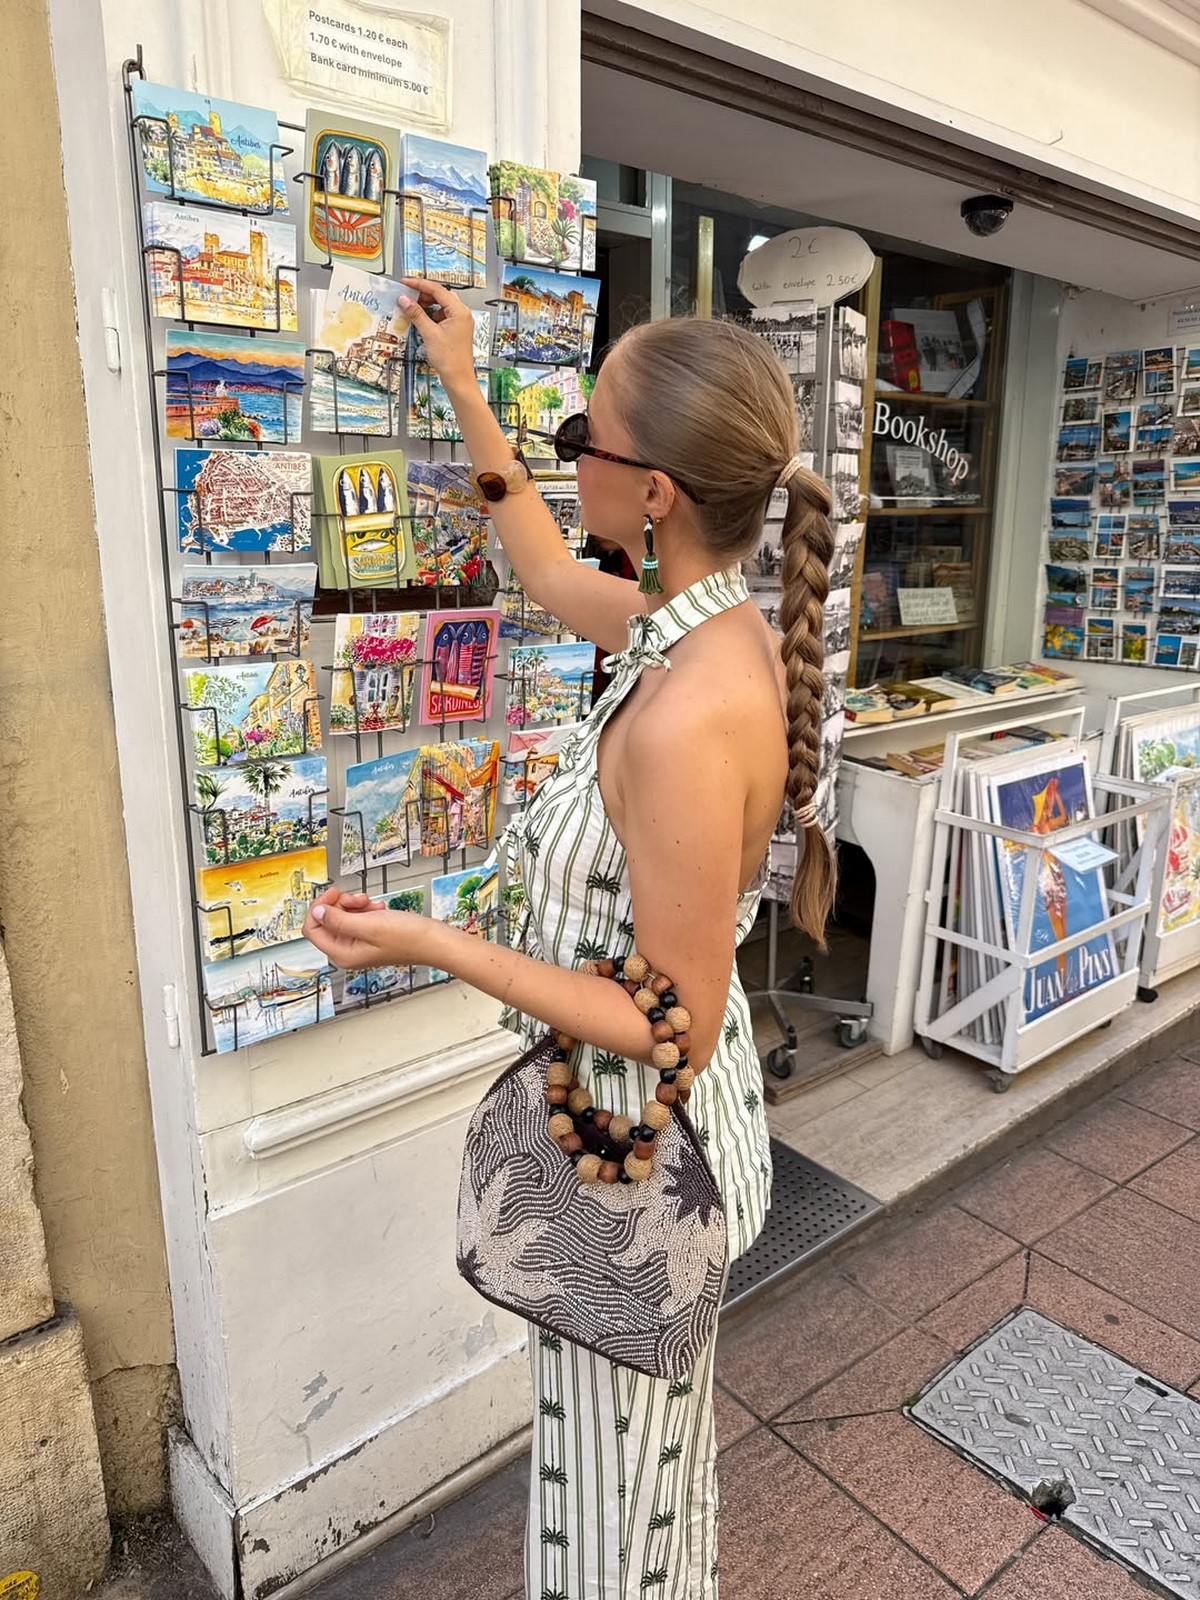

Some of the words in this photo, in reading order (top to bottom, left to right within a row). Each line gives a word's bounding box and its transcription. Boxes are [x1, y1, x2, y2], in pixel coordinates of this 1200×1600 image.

[309, 10, 356, 34] Postcards
[358, 27, 377, 40] 1.20
[378, 33, 385, 43] €
[386, 37, 408, 50] each
[310, 32, 330, 46] 1.70
[331, 39, 338, 48] €
[339, 42, 359, 55] with
[361, 49, 402, 68] envelope
[310, 52, 335, 68] Bank
[336, 62, 357, 75] card
[358, 68, 402, 87] minimum
[403, 80, 422, 93] 5.00
[423, 86, 429, 95] €
[231, 135, 261, 149] Antibes
[337, 284, 381, 311] Antibes
[783, 276, 817, 293] envelope
[872, 401, 969, 486] Bookshop
[274, 462, 307, 471] ANTIBES
